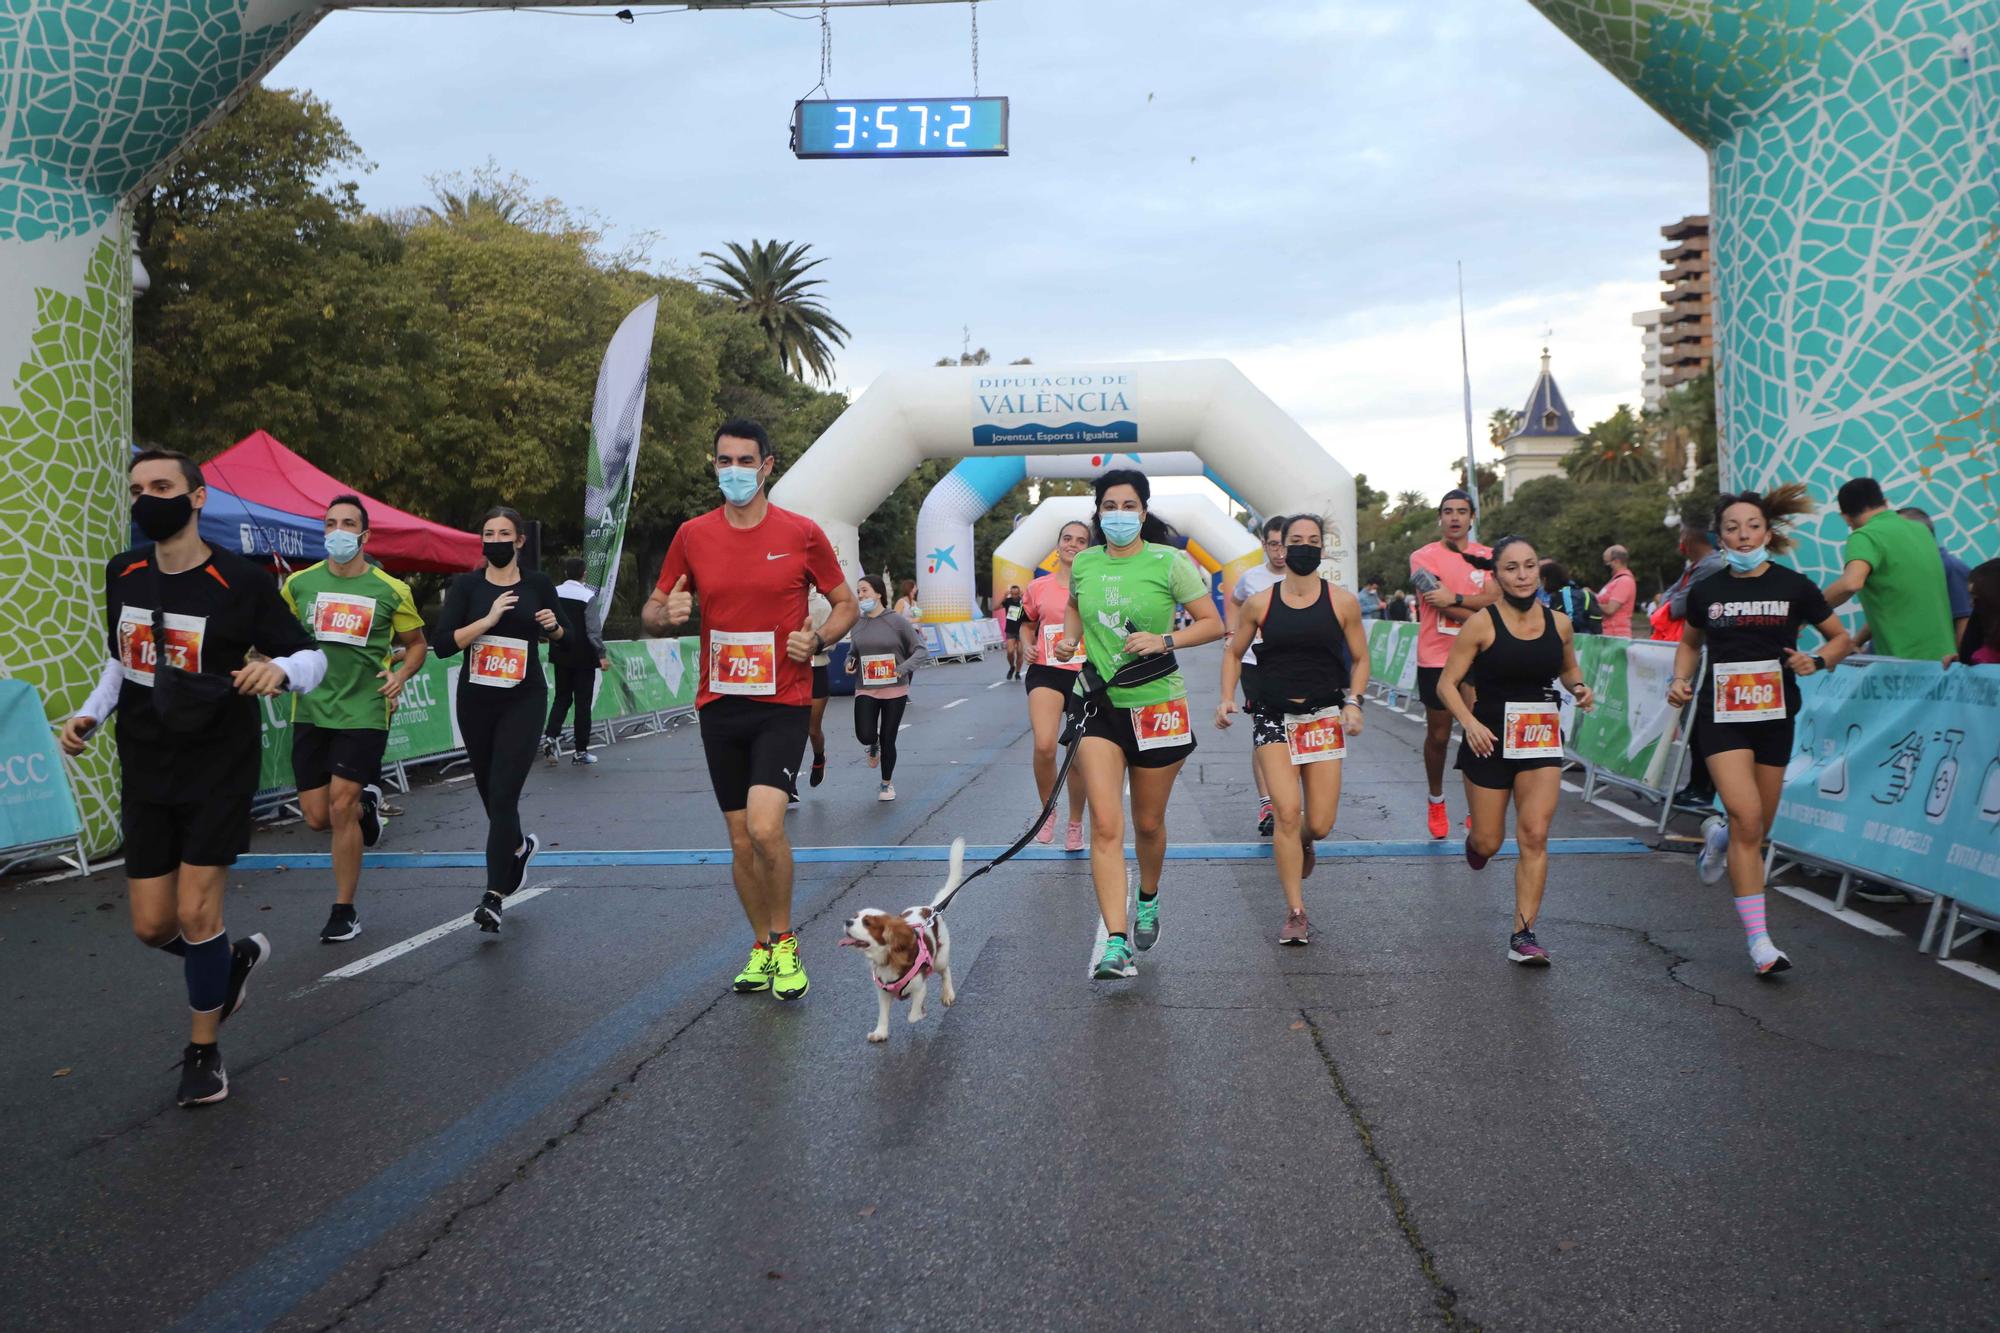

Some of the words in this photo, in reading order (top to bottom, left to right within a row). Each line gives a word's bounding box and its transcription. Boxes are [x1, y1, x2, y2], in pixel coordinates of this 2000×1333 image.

[833, 105, 971, 149] 3:57:2
[1102, 375, 1128, 385] DE
[978, 389, 1130, 415] VALÈNCIA
[1037, 431, 1074, 442] Esports
[1083, 430, 1118, 442] Igualtat
[278, 528, 304, 555] RUN
[1724, 600, 1790, 617] SPARTAN
[331, 611, 363, 630] 1861
[484, 655, 518, 674] 1846
[728, 657, 760, 677] 795
[1733, 684, 1774, 704] 1468
[1153, 710, 1180, 732] 796
[1304, 727, 1335, 747] 1133
[1523, 724, 1553, 742] 1076
